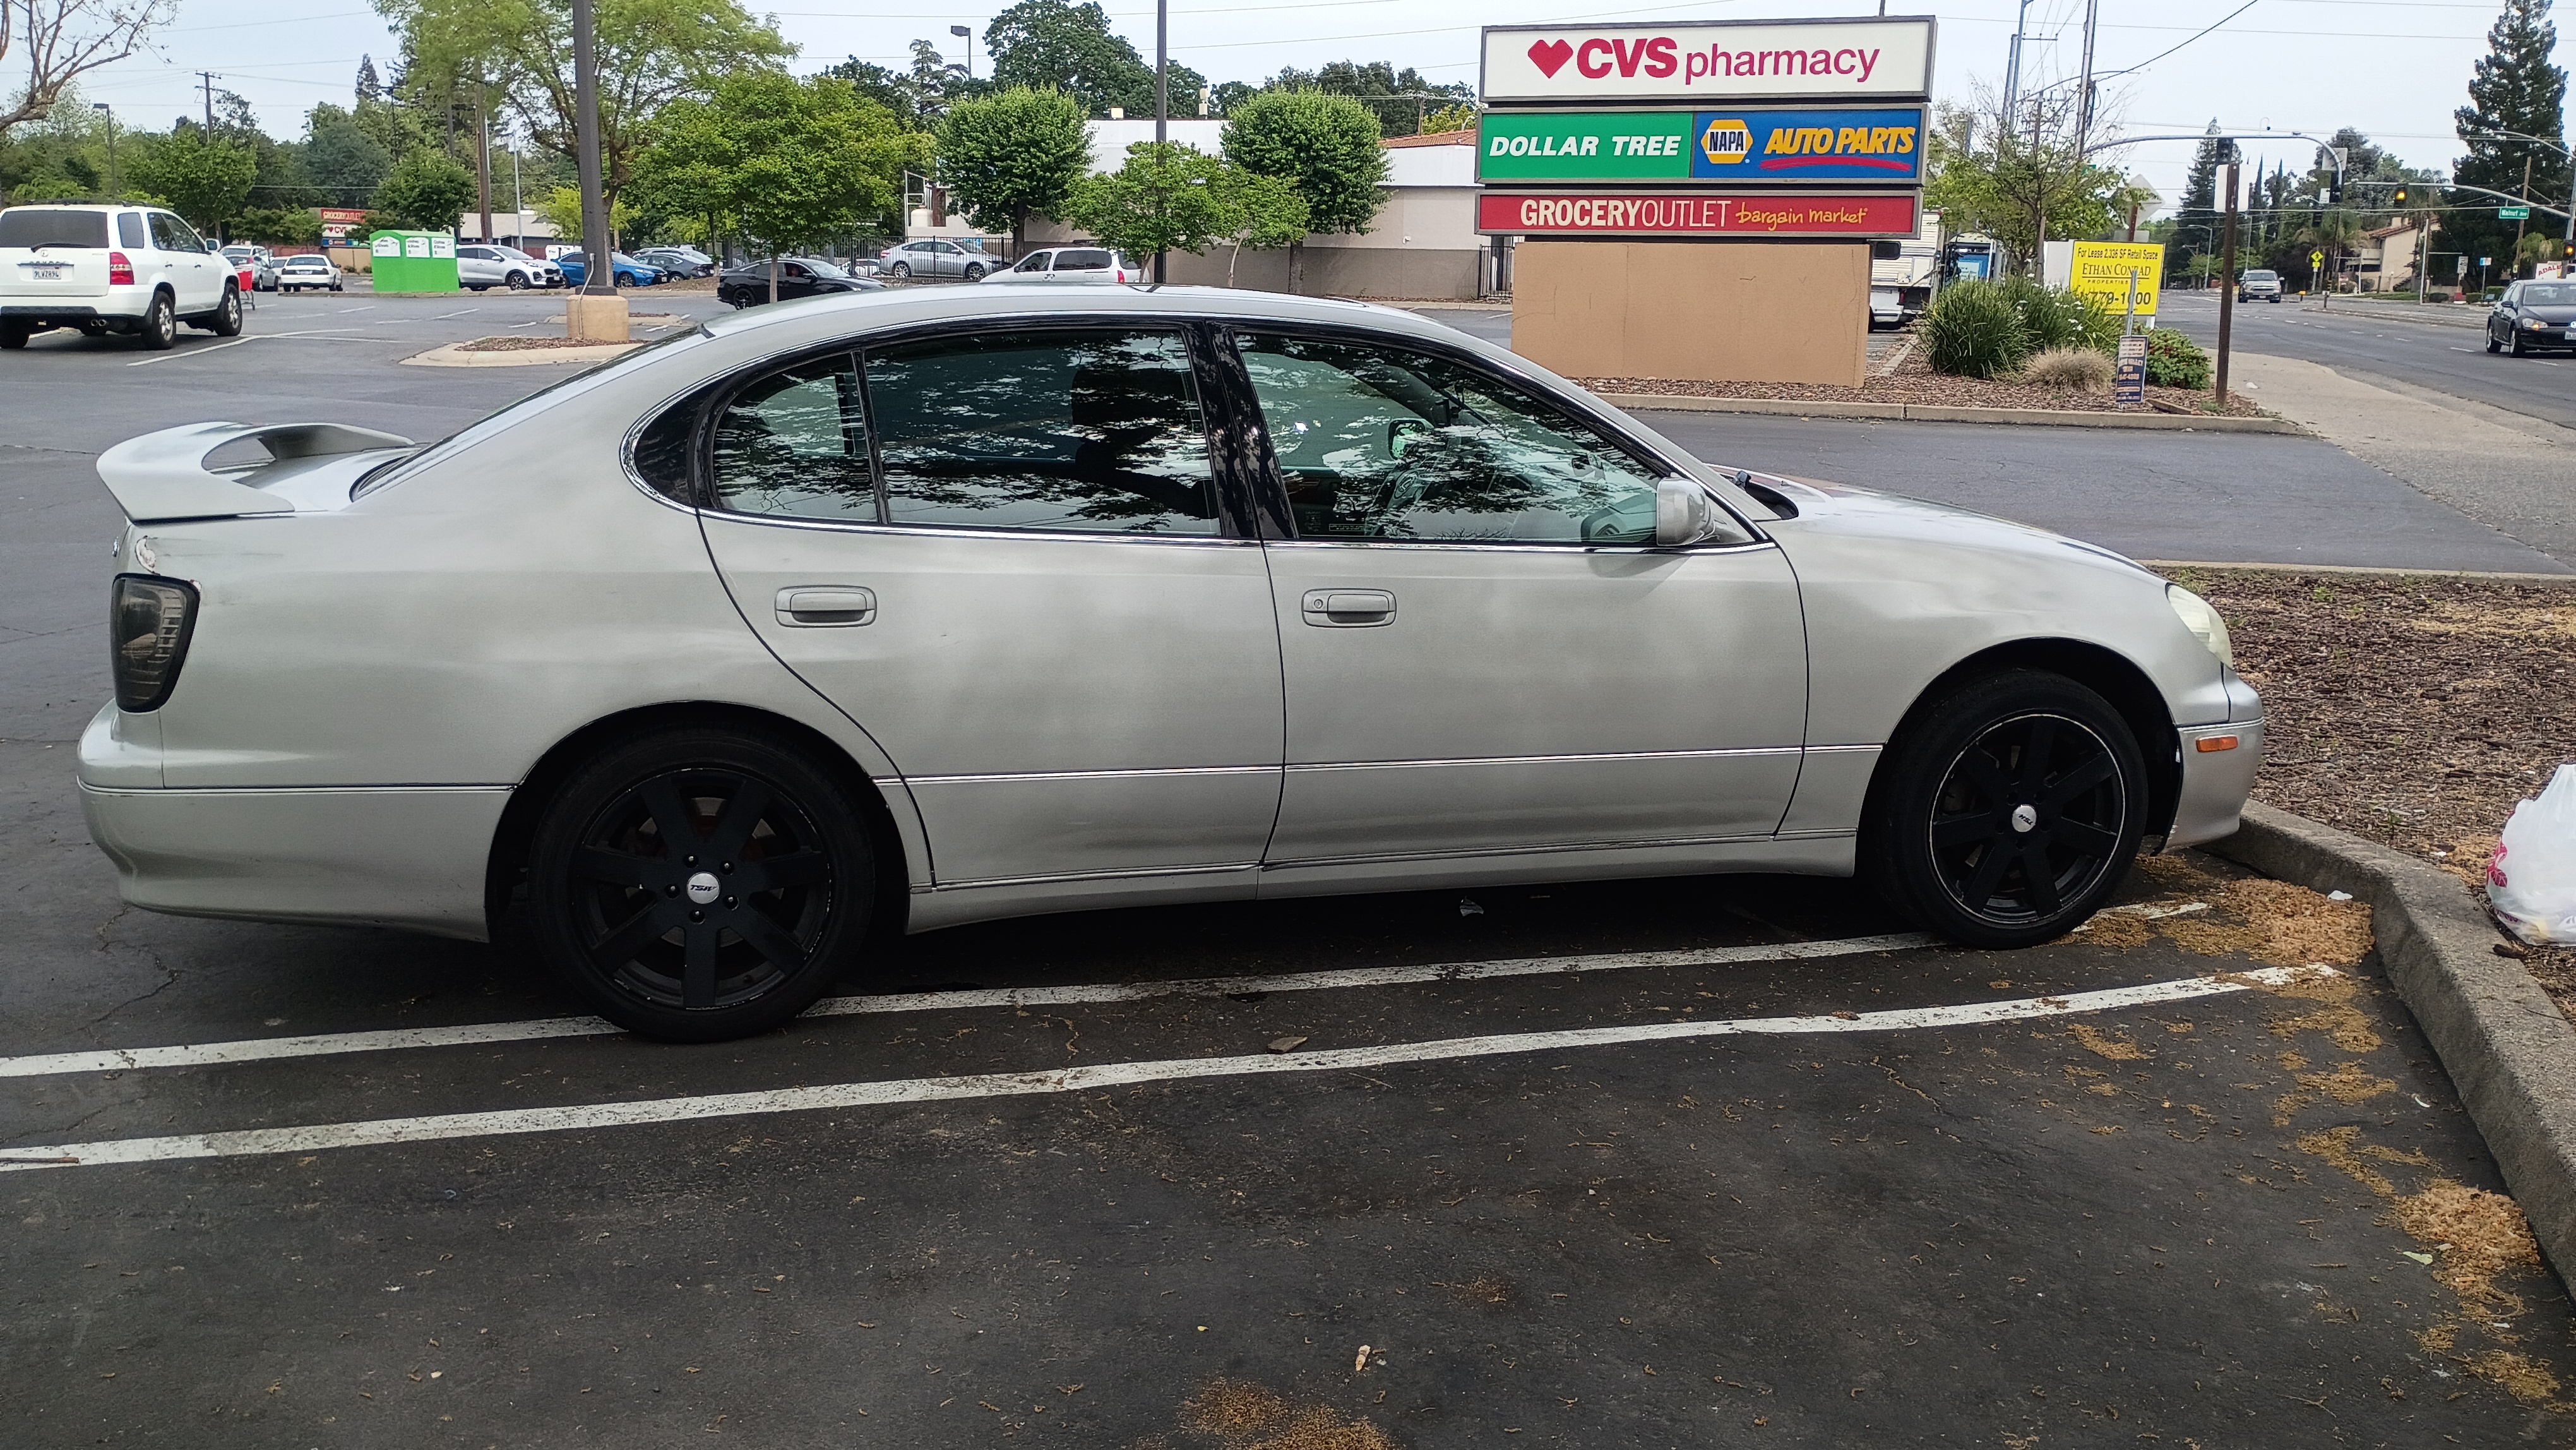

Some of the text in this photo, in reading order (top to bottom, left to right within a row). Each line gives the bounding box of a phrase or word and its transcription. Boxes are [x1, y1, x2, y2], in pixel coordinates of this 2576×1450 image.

[1577, 37, 1880, 85] CVS pharmacy
[1489, 136, 1682, 157] DOLLAR TREE
[1708, 131, 1744, 152] NAPA
[1763, 127, 1916, 154] AUTO PARTS
[1736, 202, 1803, 231] bargain
[1810, 207, 1867, 224] market
[2077, 248, 2087, 258] For
[2088, 248, 2103, 258] Lease
[2120, 249, 2126, 259] SF
[2128, 249, 2142, 260] Retail
[2143, 249, 2158, 261] Space
[2082, 263, 2113, 275] ETHAN
